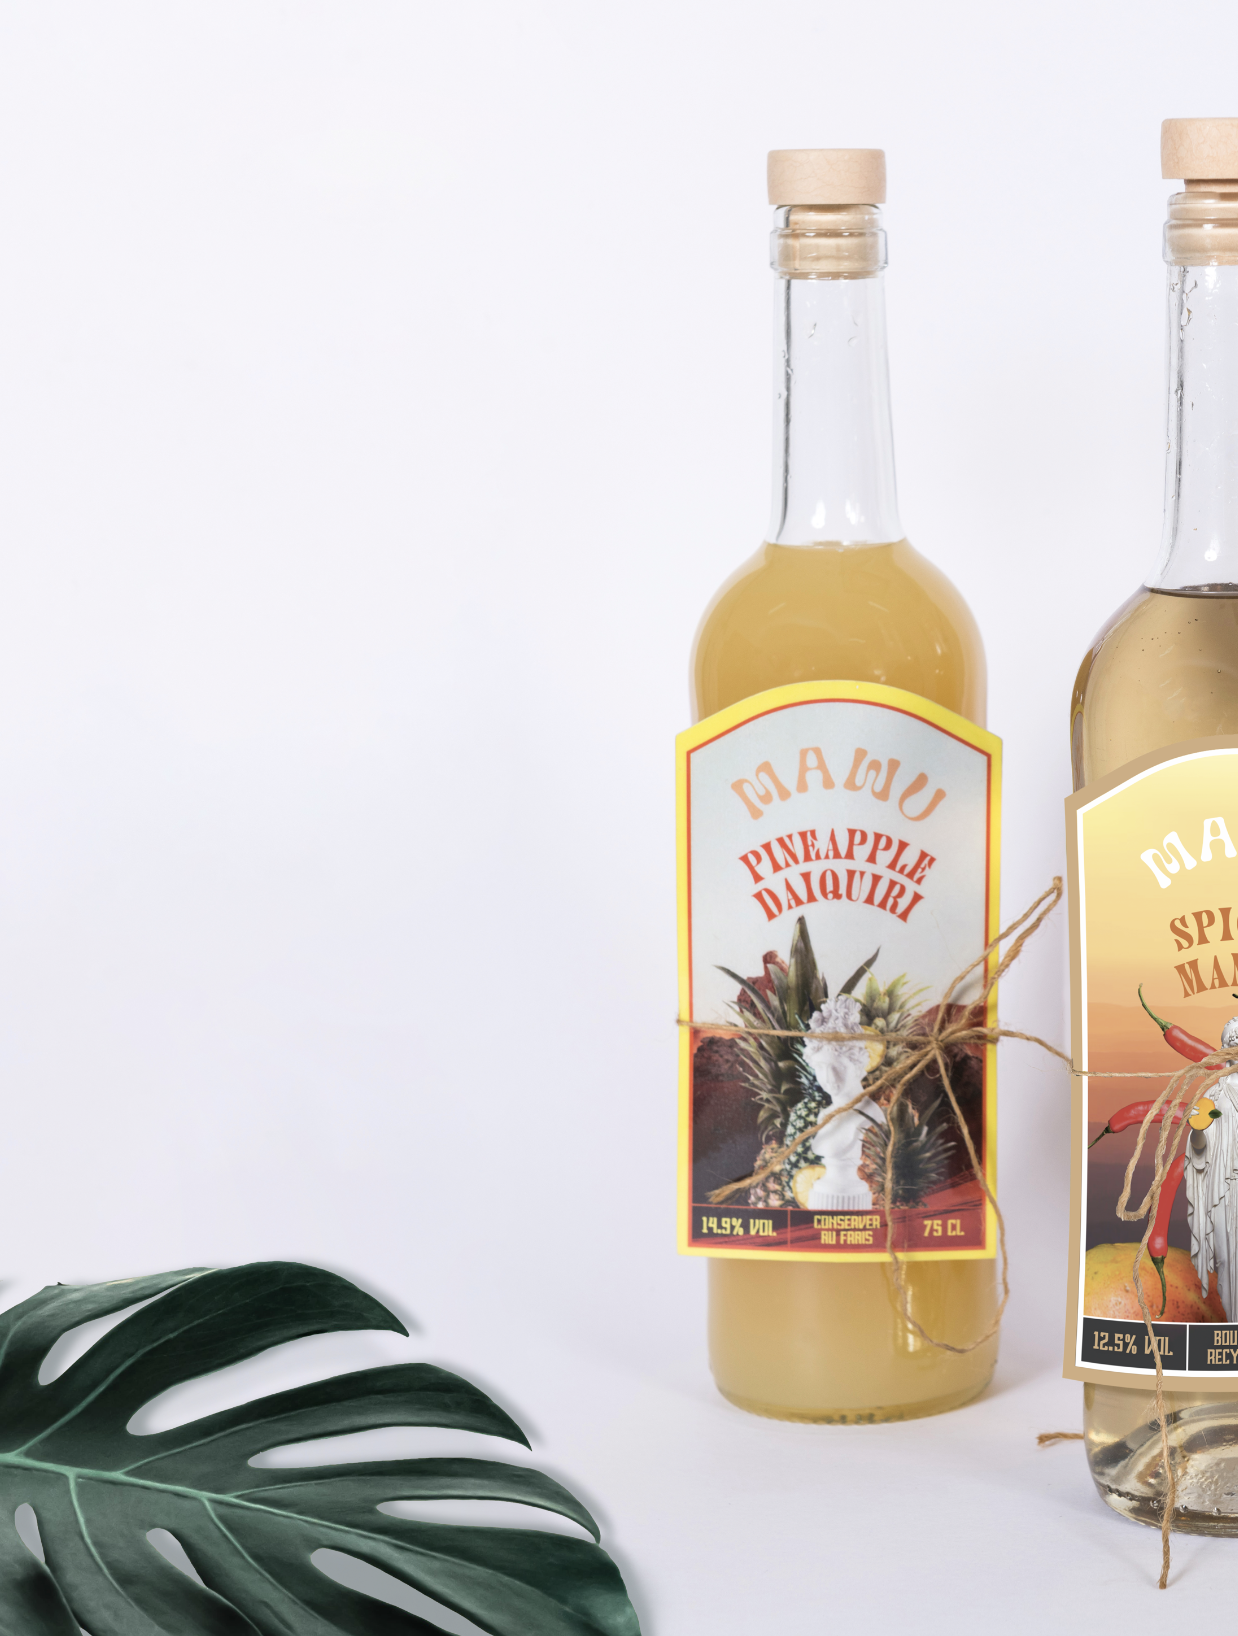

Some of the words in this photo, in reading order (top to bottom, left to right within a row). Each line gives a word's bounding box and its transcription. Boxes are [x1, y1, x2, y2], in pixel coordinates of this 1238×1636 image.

[730, 746, 947, 821] MAWU
[738, 828, 937, 886] PINEAPPLE
[751, 868, 925, 924] DAIQUIRI
[701, 1216, 744, 1236] 14.9%
[749, 1219, 777, 1237] VOL
[813, 1215, 881, 1230] CONSERVER
[923, 1220, 942, 1237] 75
[947, 1219, 965, 1236] CL
[820, 1230, 837, 1245] AU
[839, 1230, 874, 1245] FRAIS
[1093, 1331, 1138, 1355] 12.5%
